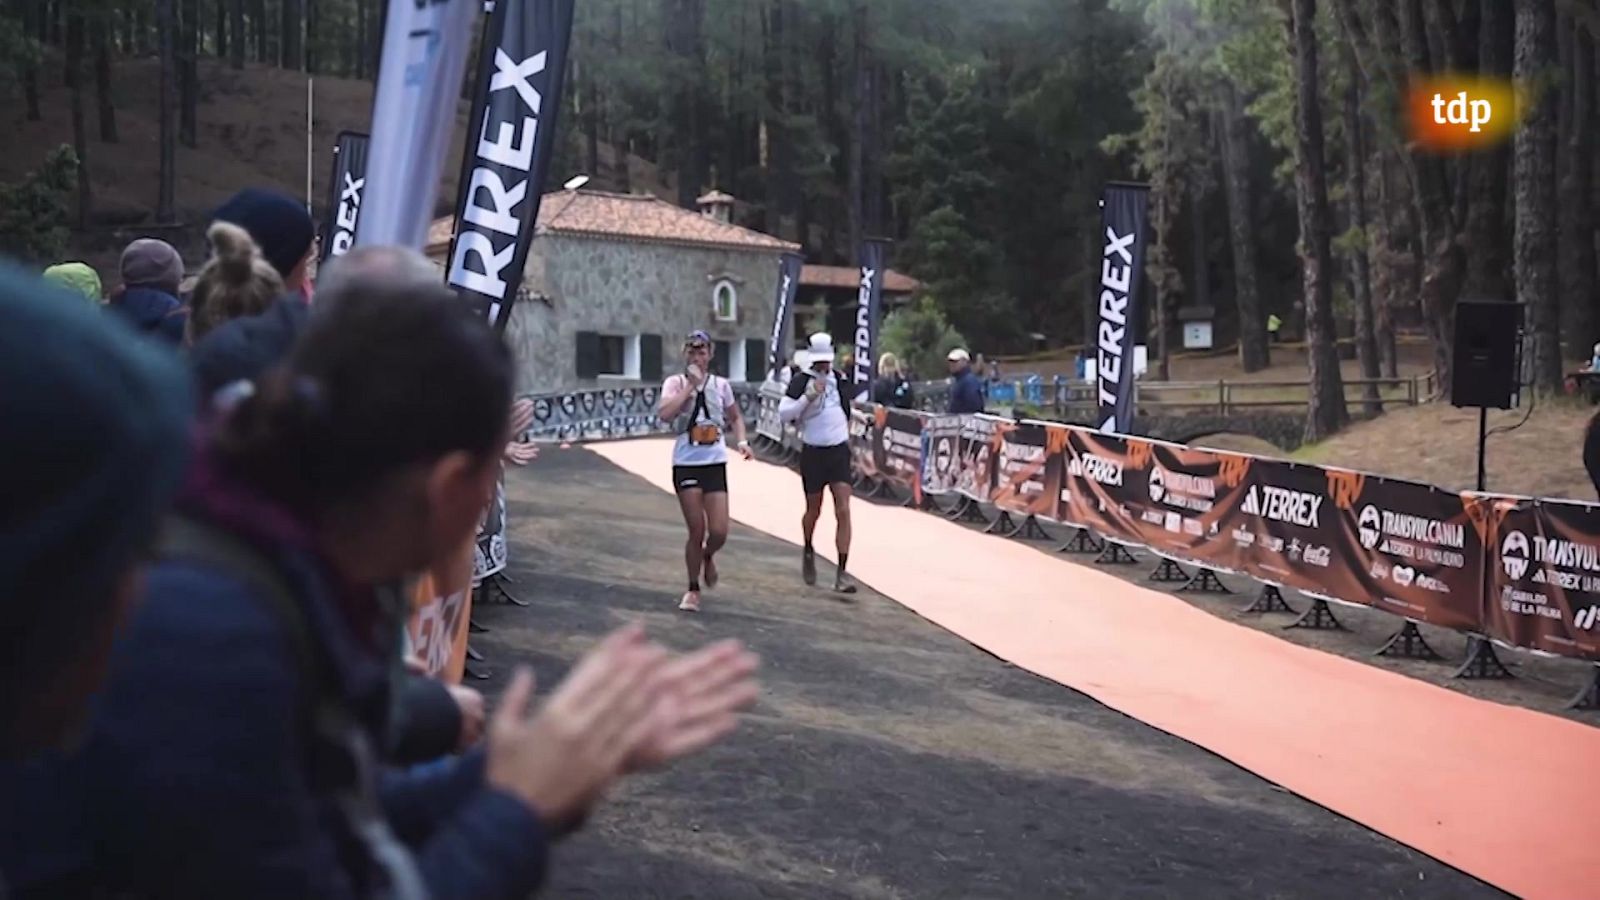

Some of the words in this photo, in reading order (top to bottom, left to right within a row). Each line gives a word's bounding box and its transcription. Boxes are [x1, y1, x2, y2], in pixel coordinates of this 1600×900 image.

[331, 171, 365, 257] REX
[449, 47, 547, 326] RREX
[1098, 225, 1136, 407] TERREX
[1261, 485, 1323, 529] TERREX
[1381, 510, 1465, 549] TRANSVULCANIA
[1532, 535, 1600, 571] TRANSVUL
